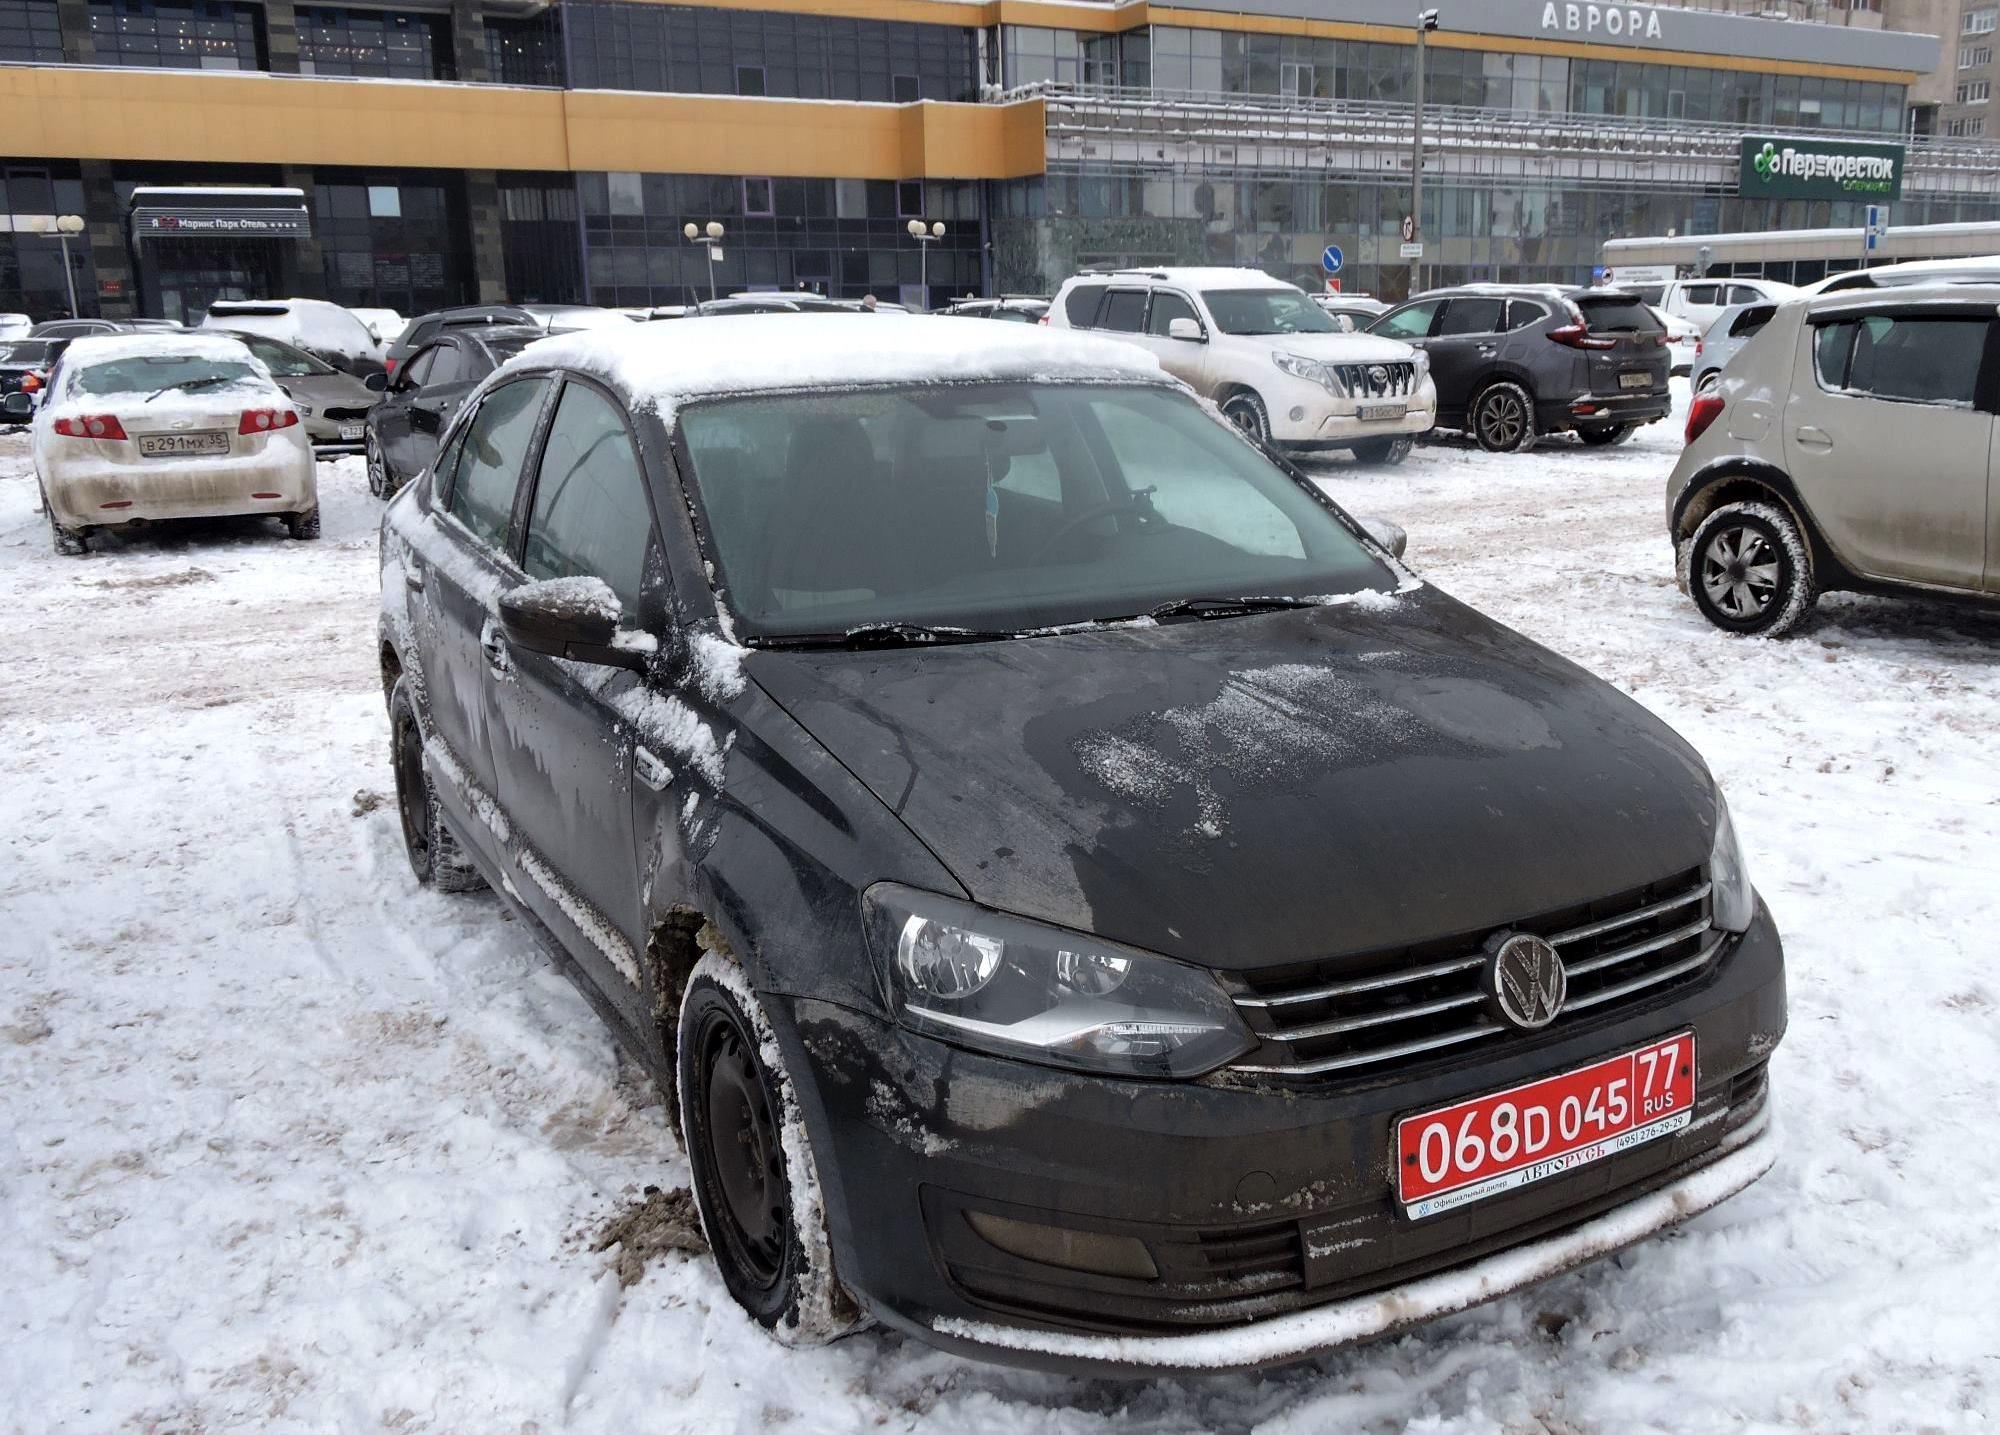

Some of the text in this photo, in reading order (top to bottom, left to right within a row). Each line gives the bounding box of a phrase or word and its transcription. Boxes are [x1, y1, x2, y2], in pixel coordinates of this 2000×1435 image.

[1541, 1, 1662, 39] АВРОРА
[1781, 147, 1894, 182] Перекресток
[178, 219, 214, 230] Маринс
[215, 219, 239, 229] Парк
[240, 219, 267, 229] Отель
[1639, 1043, 1679, 1098] 77
[1643, 1092, 1674, 1116] RUS
[1616, 1116, 1683, 1151] (495) 276-29-29
[1521, 1146, 1605, 1184] АВТОРУСЬ
[1433, 1180, 1508, 1209] Официальный дилер
